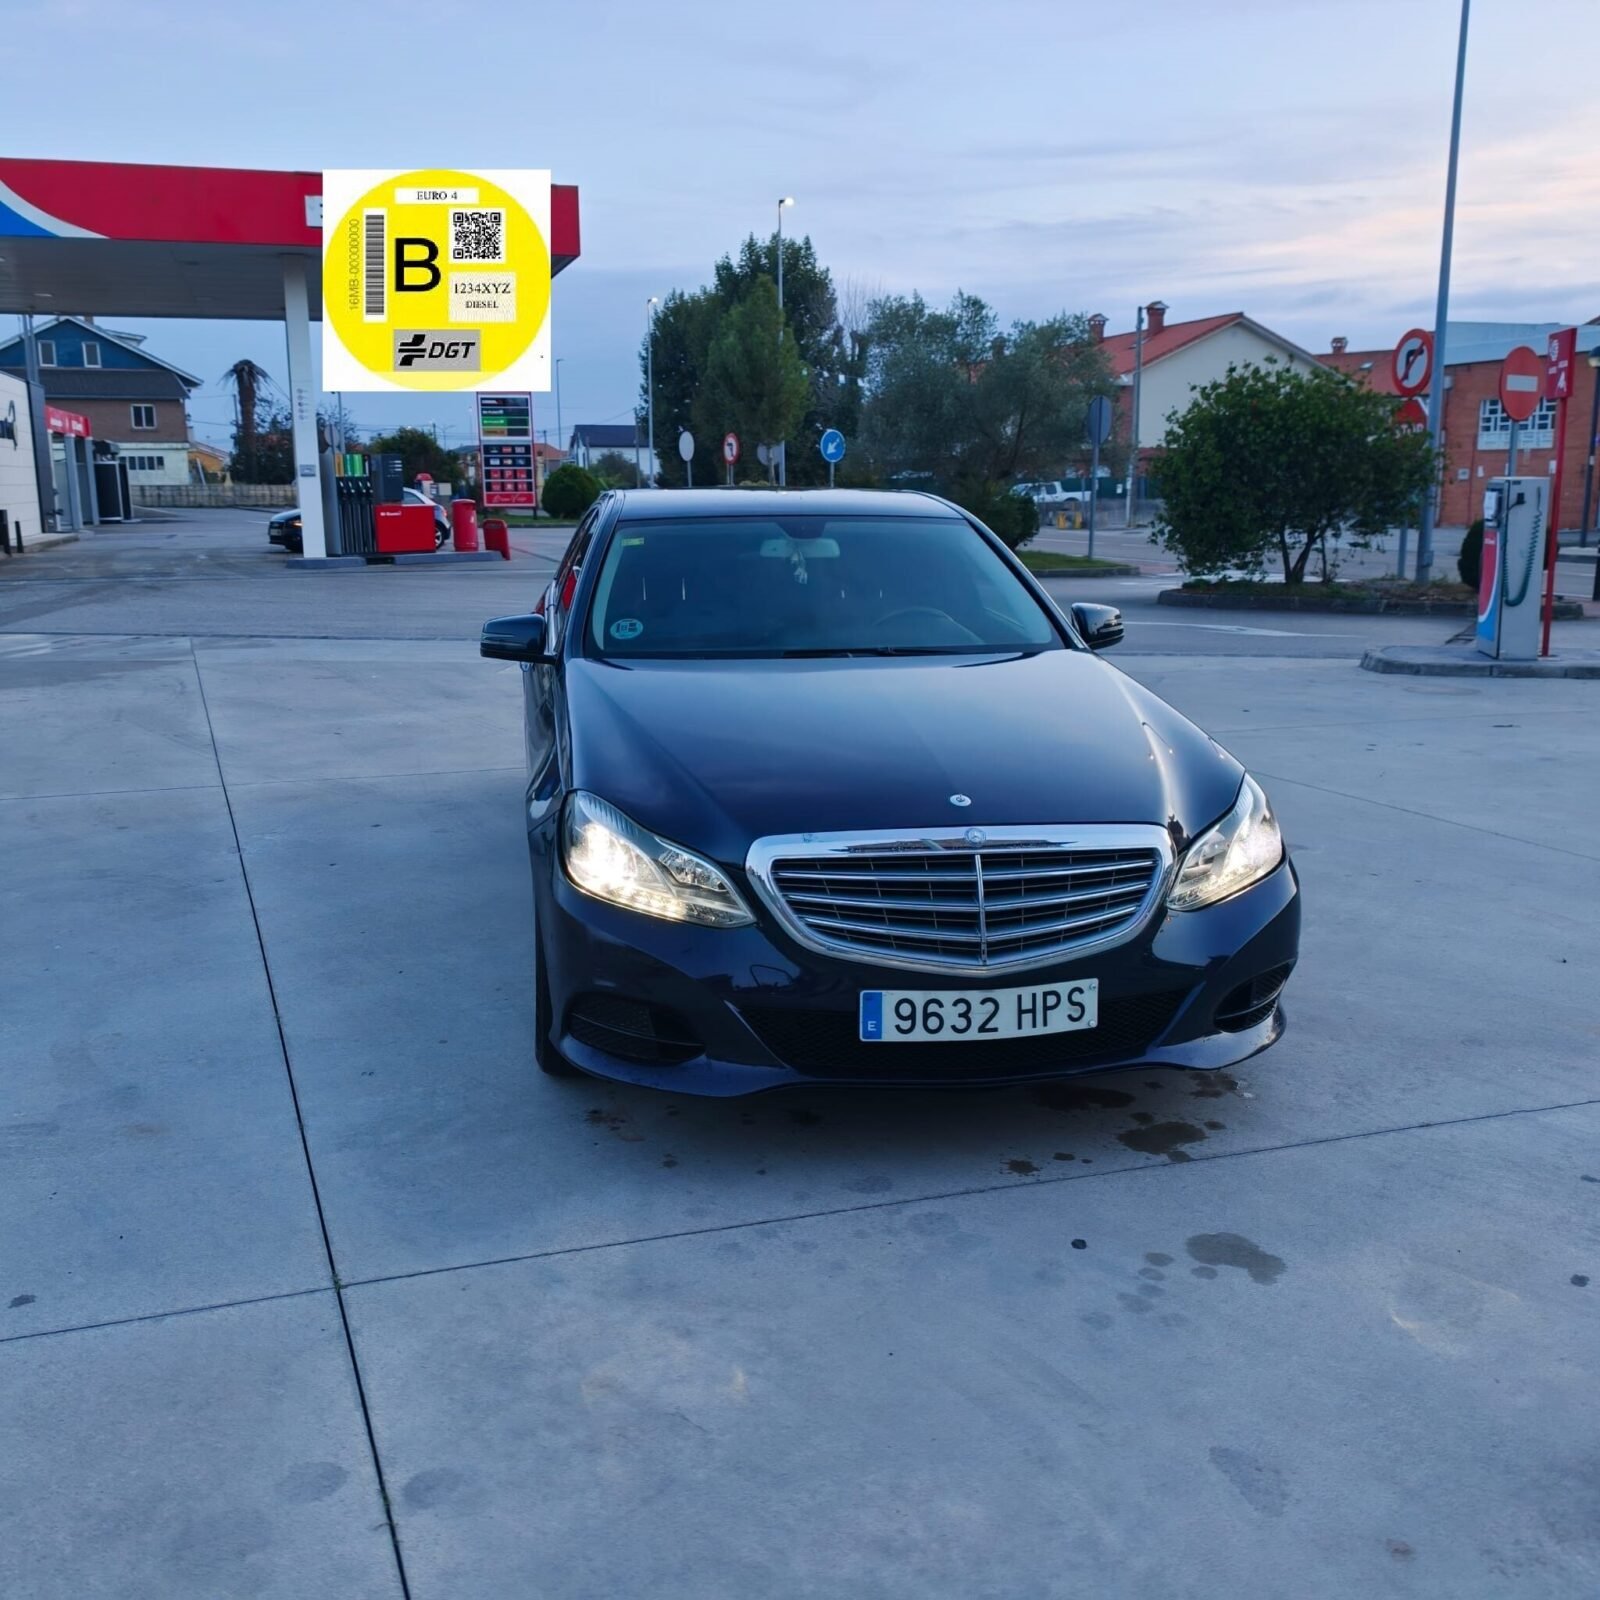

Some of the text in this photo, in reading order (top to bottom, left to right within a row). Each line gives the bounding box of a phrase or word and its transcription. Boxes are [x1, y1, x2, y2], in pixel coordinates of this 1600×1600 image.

[894, 987, 1086, 1035] 9632 HPS
[867, 1021, 877, 1031] E
